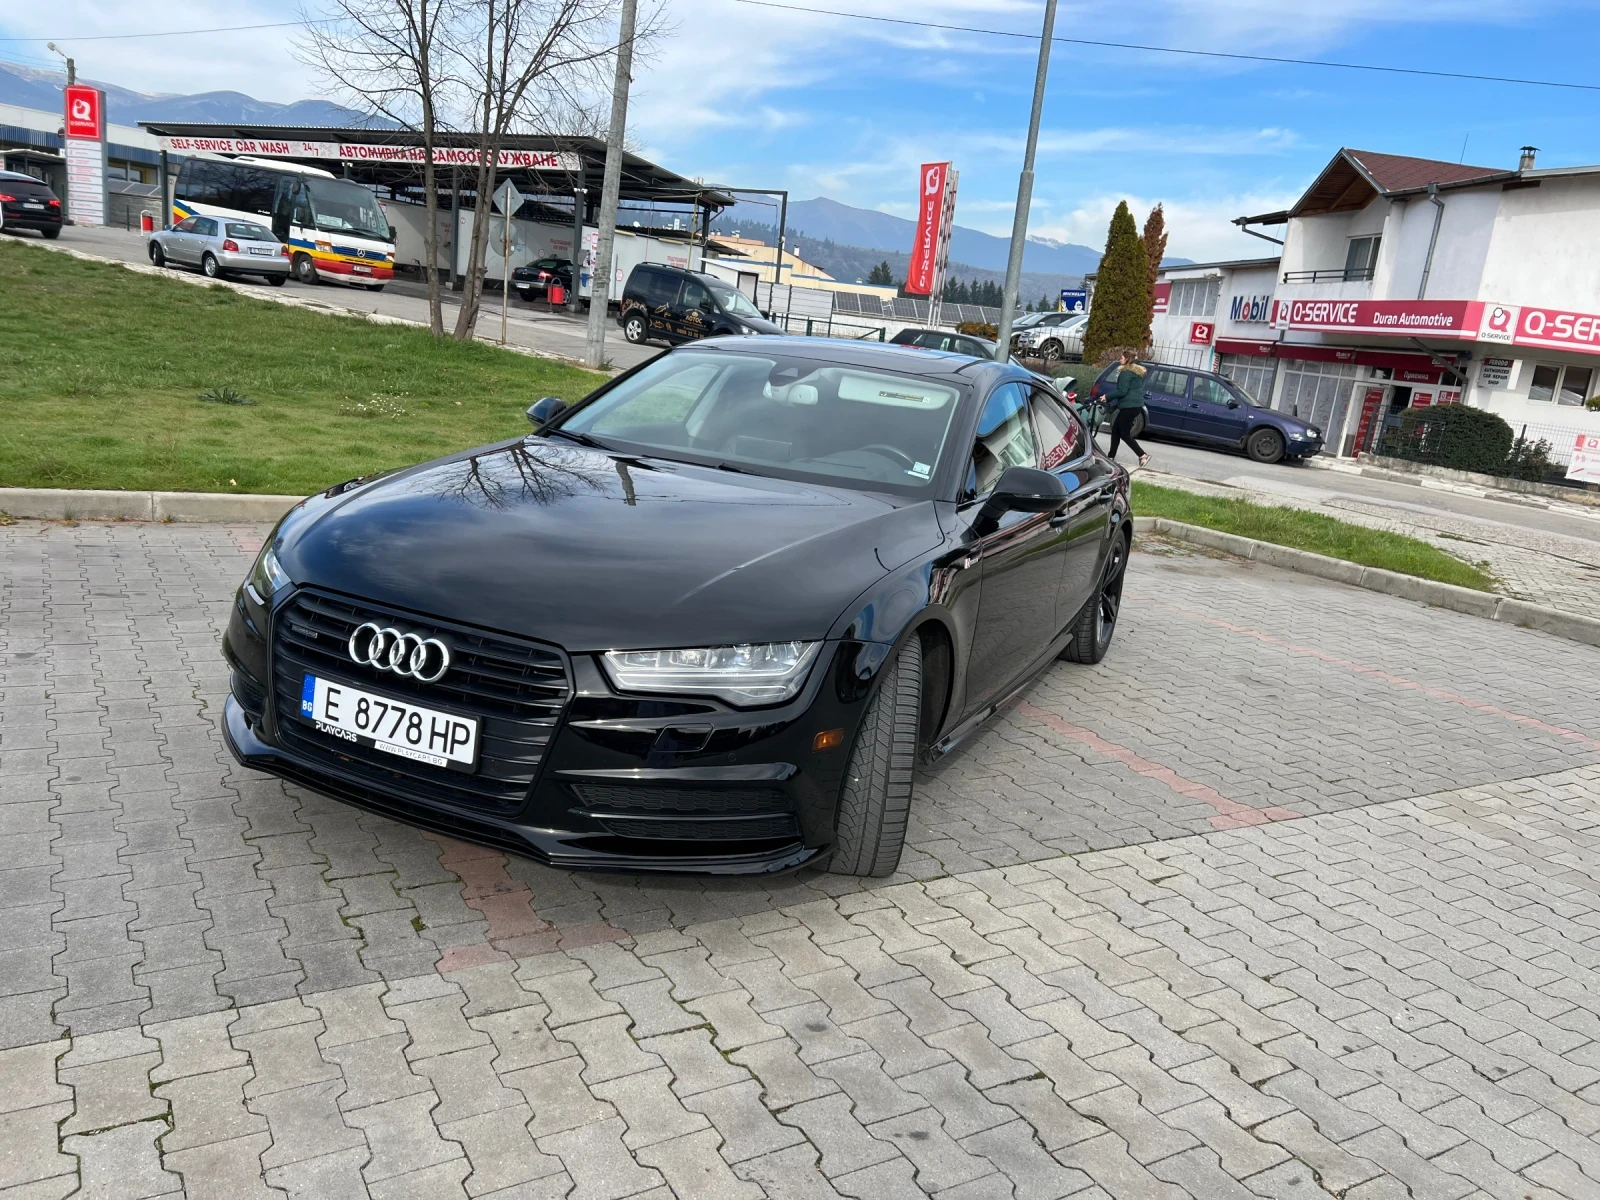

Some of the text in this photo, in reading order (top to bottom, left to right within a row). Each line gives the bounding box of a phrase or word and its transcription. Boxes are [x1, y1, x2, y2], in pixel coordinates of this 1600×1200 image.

[170, 138, 233, 152] SELF-SERVICE
[236, 140, 256, 153] CAR
[258, 141, 290, 154] WASH
[339, 145, 408, 161] АВТОМИВКА
[1230, 295, 1270, 321] Mobil
[1293, 302, 1359, 324] Q-SERVICE
[1373, 312, 1454, 327] Duran Automotive
[302, 700, 313, 712] BG
[325, 686, 471, 756] E 8778 HP
[315, 720, 358, 743] PLAYCARS
